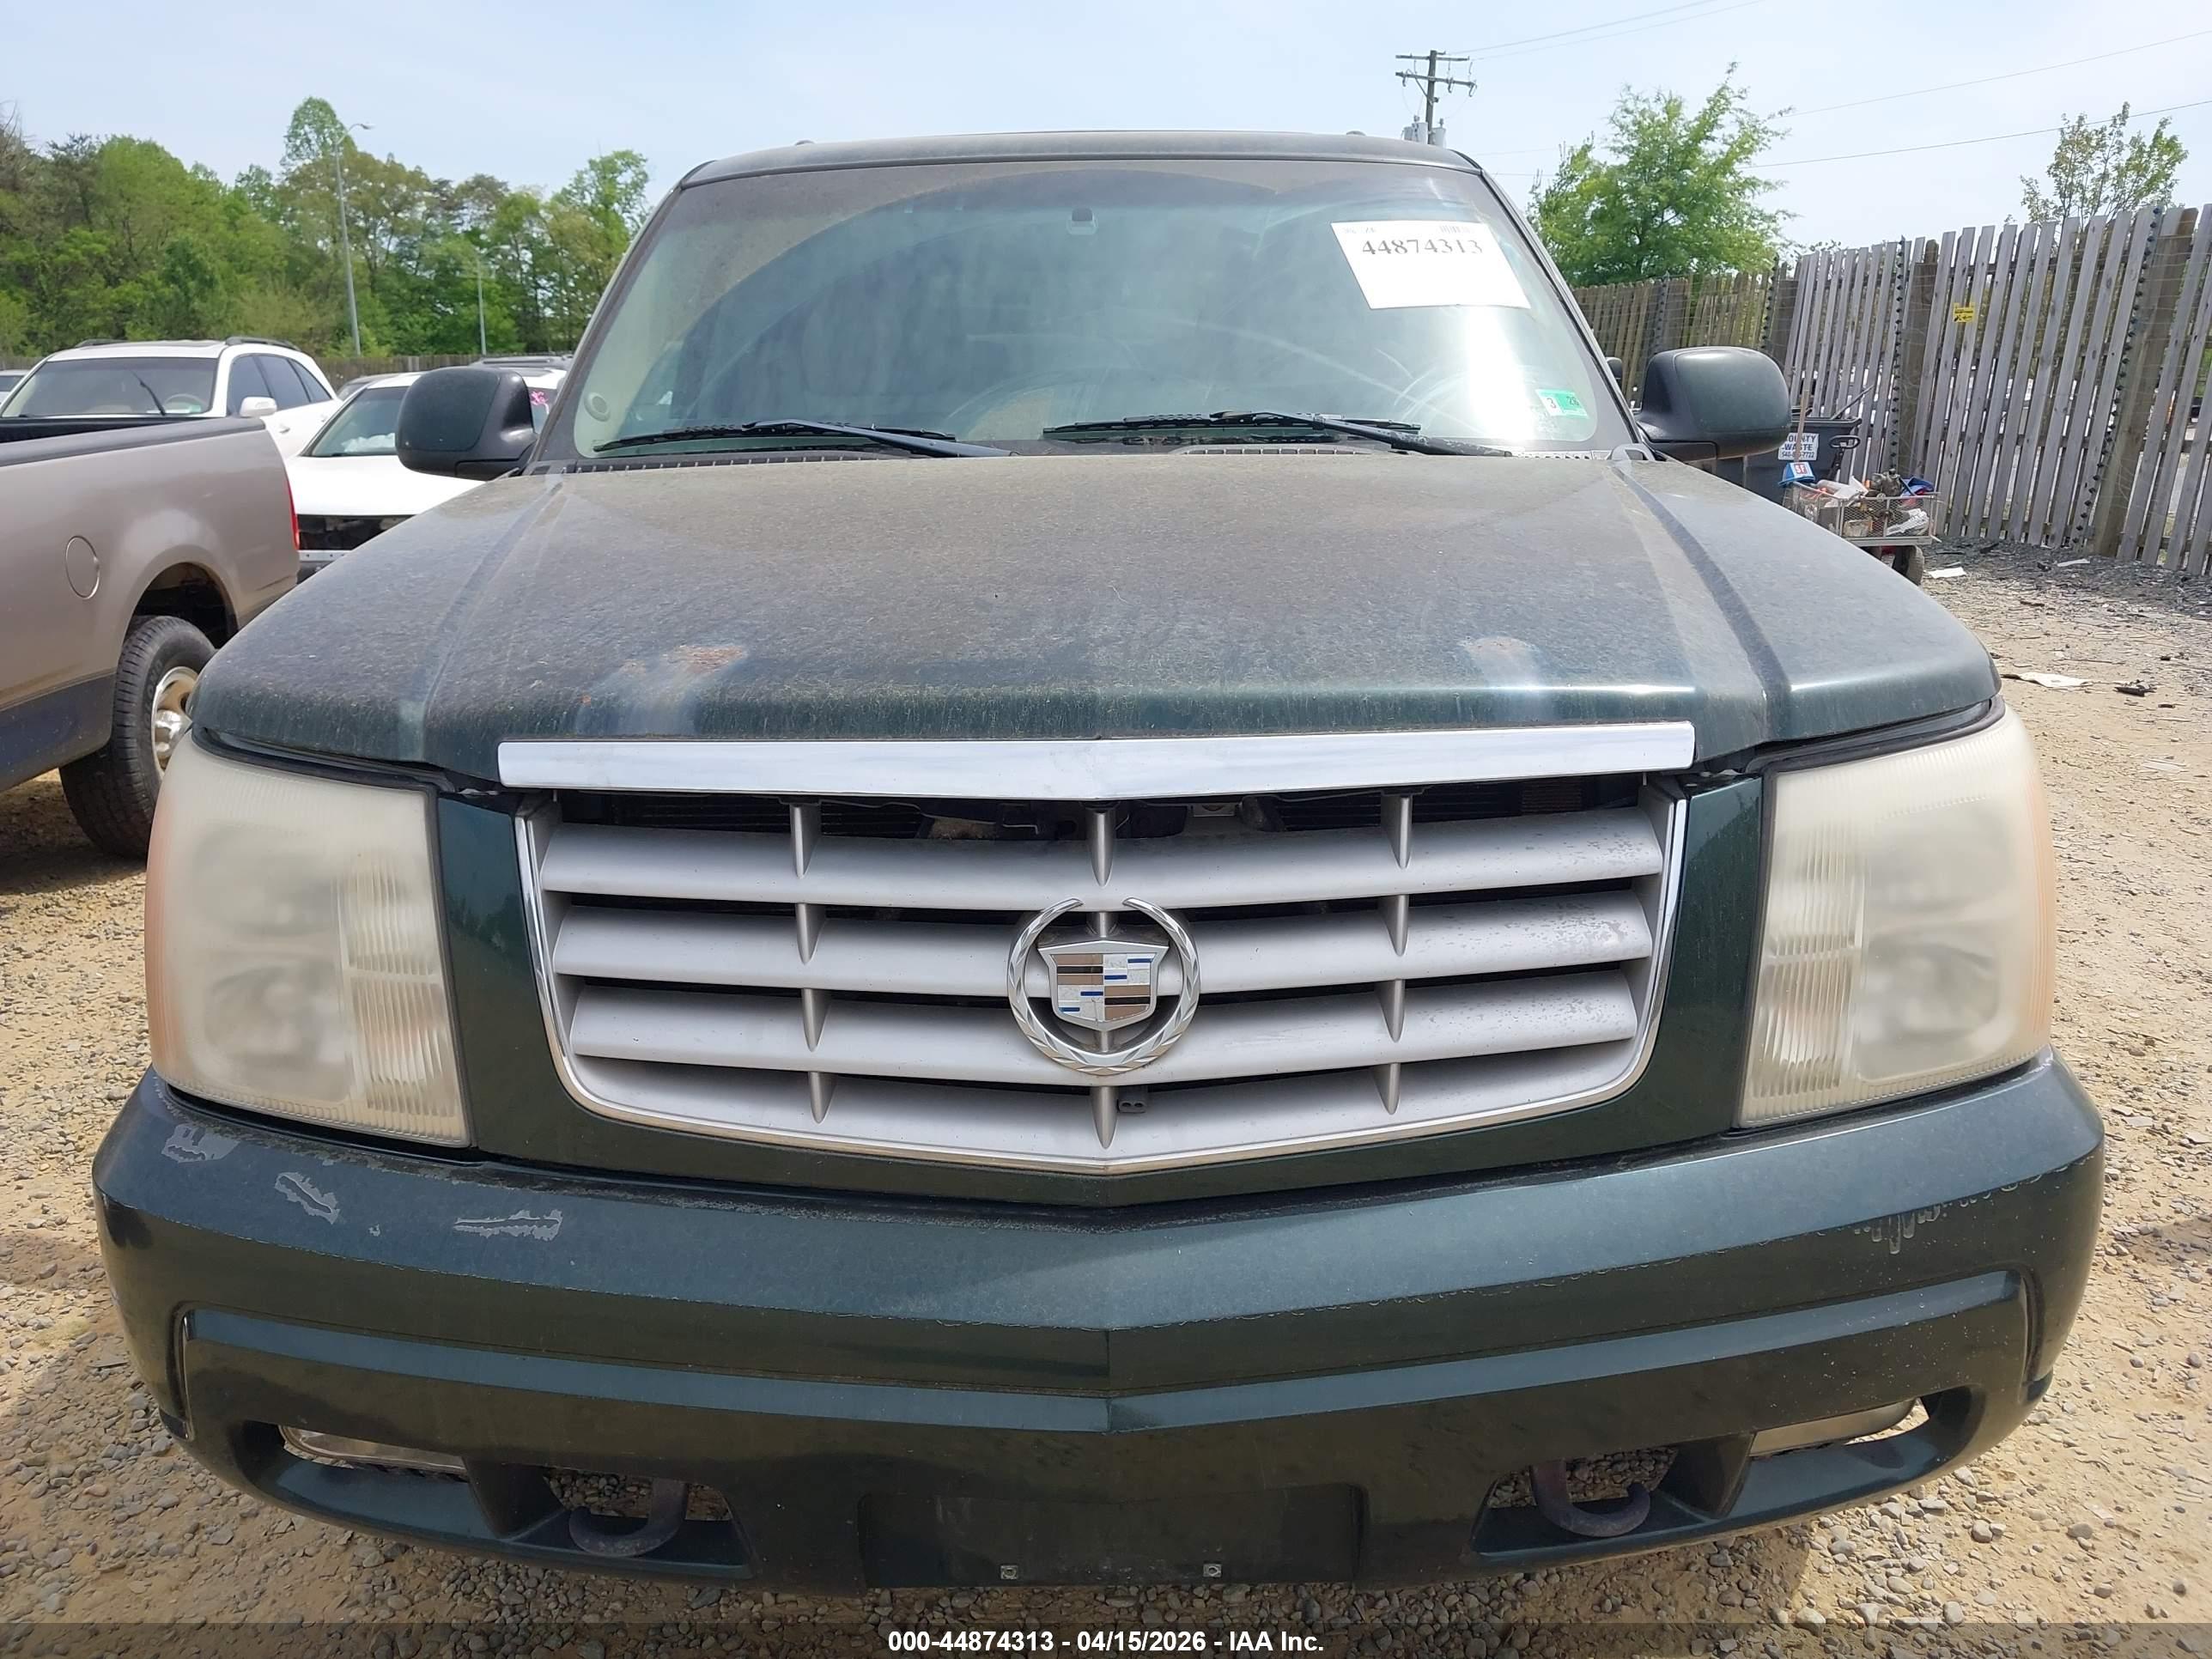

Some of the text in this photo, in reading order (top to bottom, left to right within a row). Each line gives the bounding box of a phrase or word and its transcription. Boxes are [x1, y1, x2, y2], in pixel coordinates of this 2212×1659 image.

[1362, 239, 1483, 255] 44874313
[1547, 397, 1557, 410] 3
[1788, 434, 1816, 443] OUNTY
